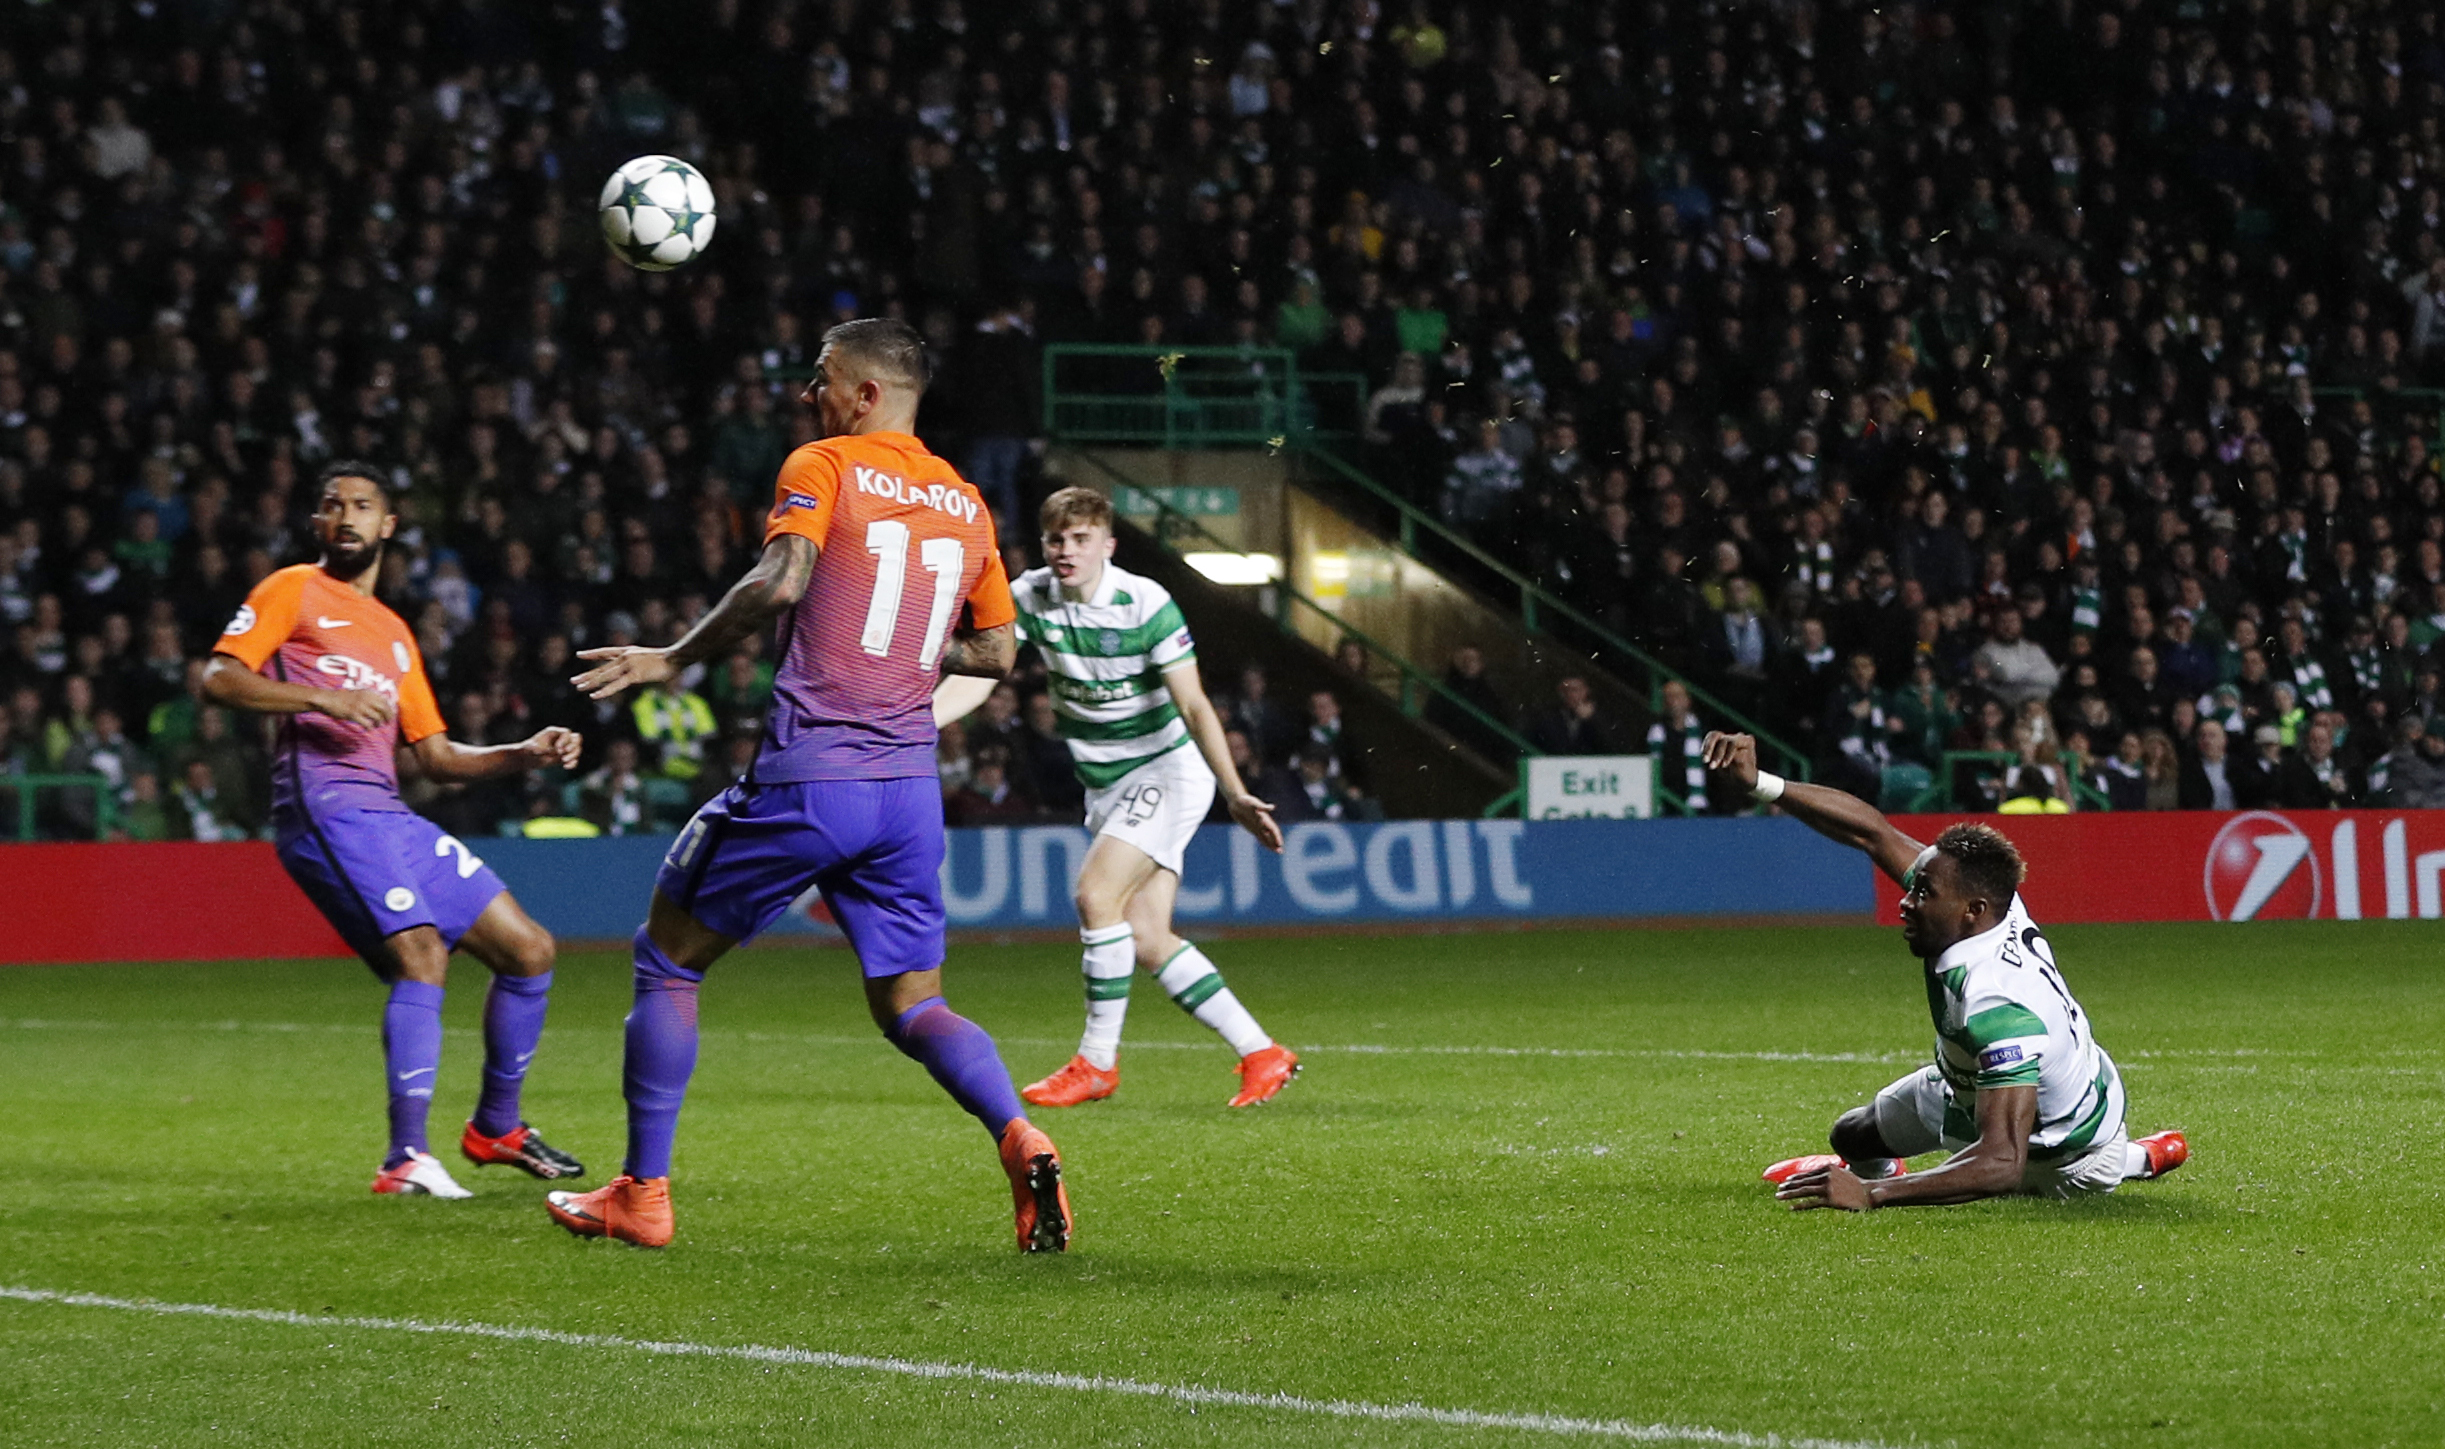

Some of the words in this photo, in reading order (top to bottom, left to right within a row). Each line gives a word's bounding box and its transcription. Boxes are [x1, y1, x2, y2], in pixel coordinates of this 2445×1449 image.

[854, 466, 978, 525] KOLAROV
[859, 519, 965, 672] 11
[1121, 783, 1162, 820] 49
[1562, 770, 1618, 795] Exit
[434, 834, 484, 879] 2
[1988, 1048, 2022, 1063] RESPECT
